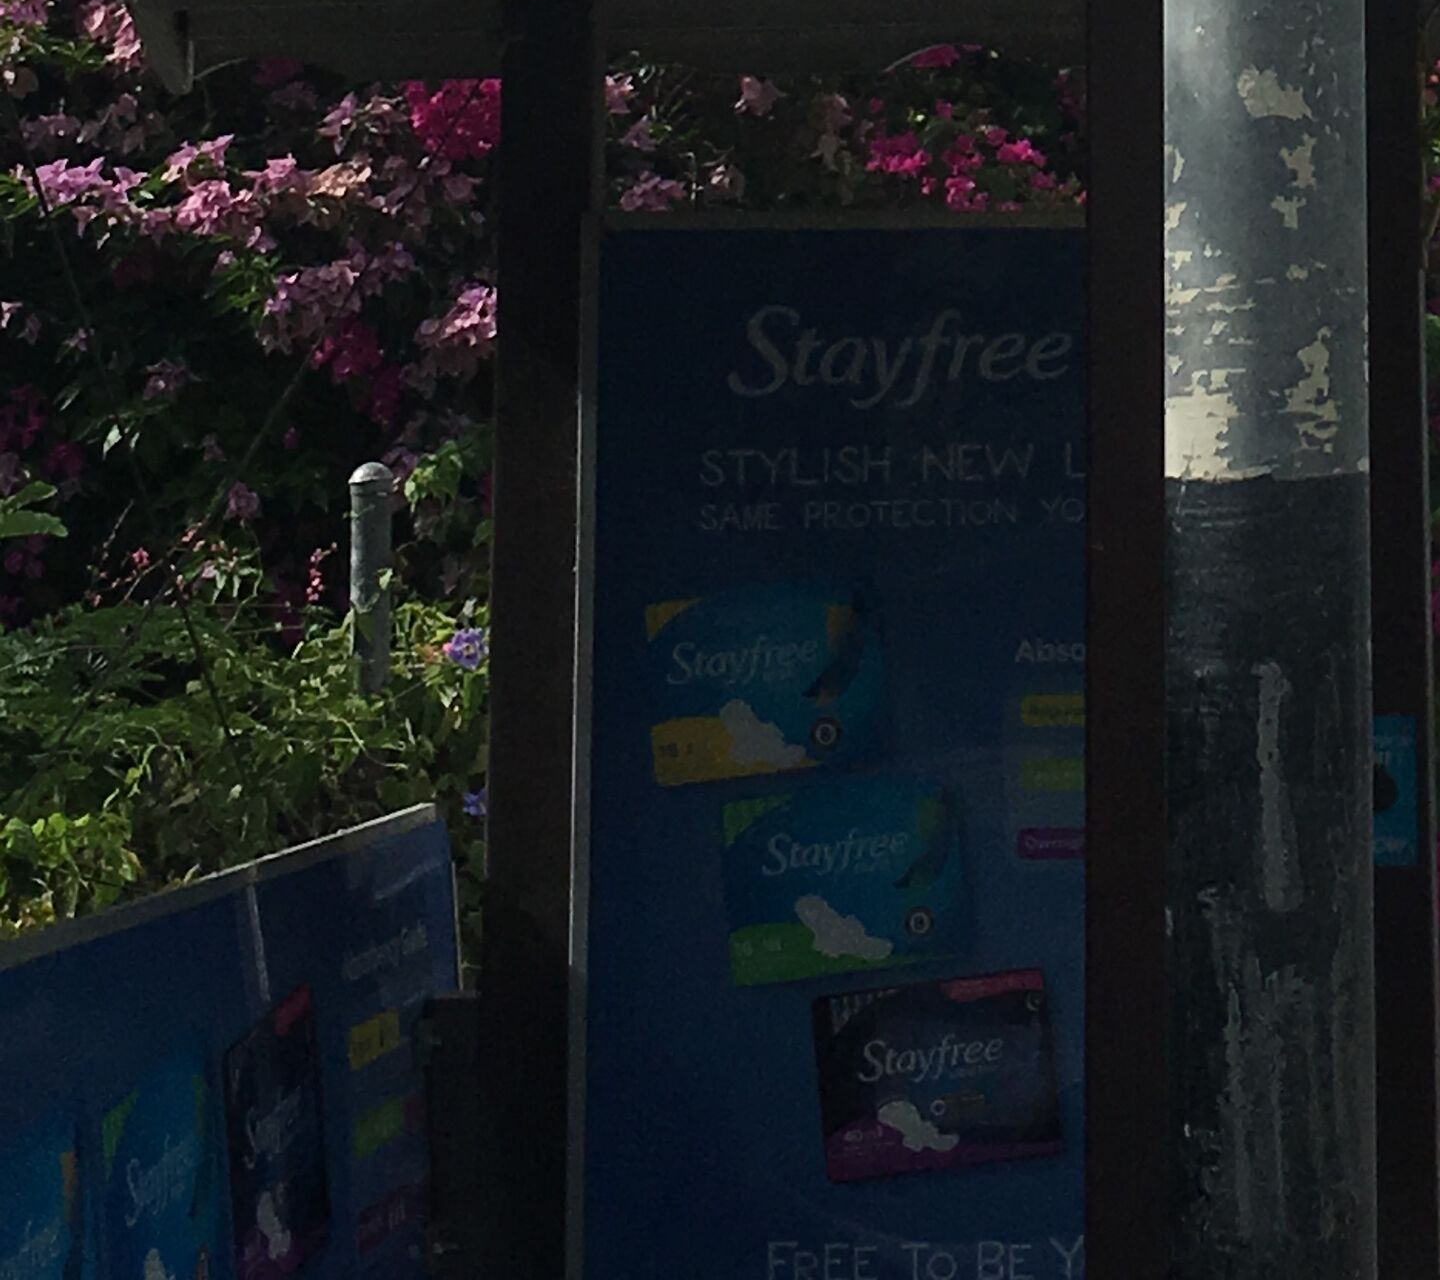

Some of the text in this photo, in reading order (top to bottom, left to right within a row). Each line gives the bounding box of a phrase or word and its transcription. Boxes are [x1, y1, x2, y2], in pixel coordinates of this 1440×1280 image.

[728, 305, 1071, 409] Stayfree
[700, 445, 892, 486] STYLISH
[921, 444, 1034, 481] NEW
[700, 504, 780, 530] SAME
[805, 500, 1017, 529] PROTECTION
[668, 637, 816, 684] Stayfree
[763, 829, 909, 877] Stayfree
[858, 1035, 1003, 1083] Stayfree
[768, 1242, 877, 1280] FREE
[903, 1244, 955, 1280] TO
[979, 1240, 1032, 1280] BE
